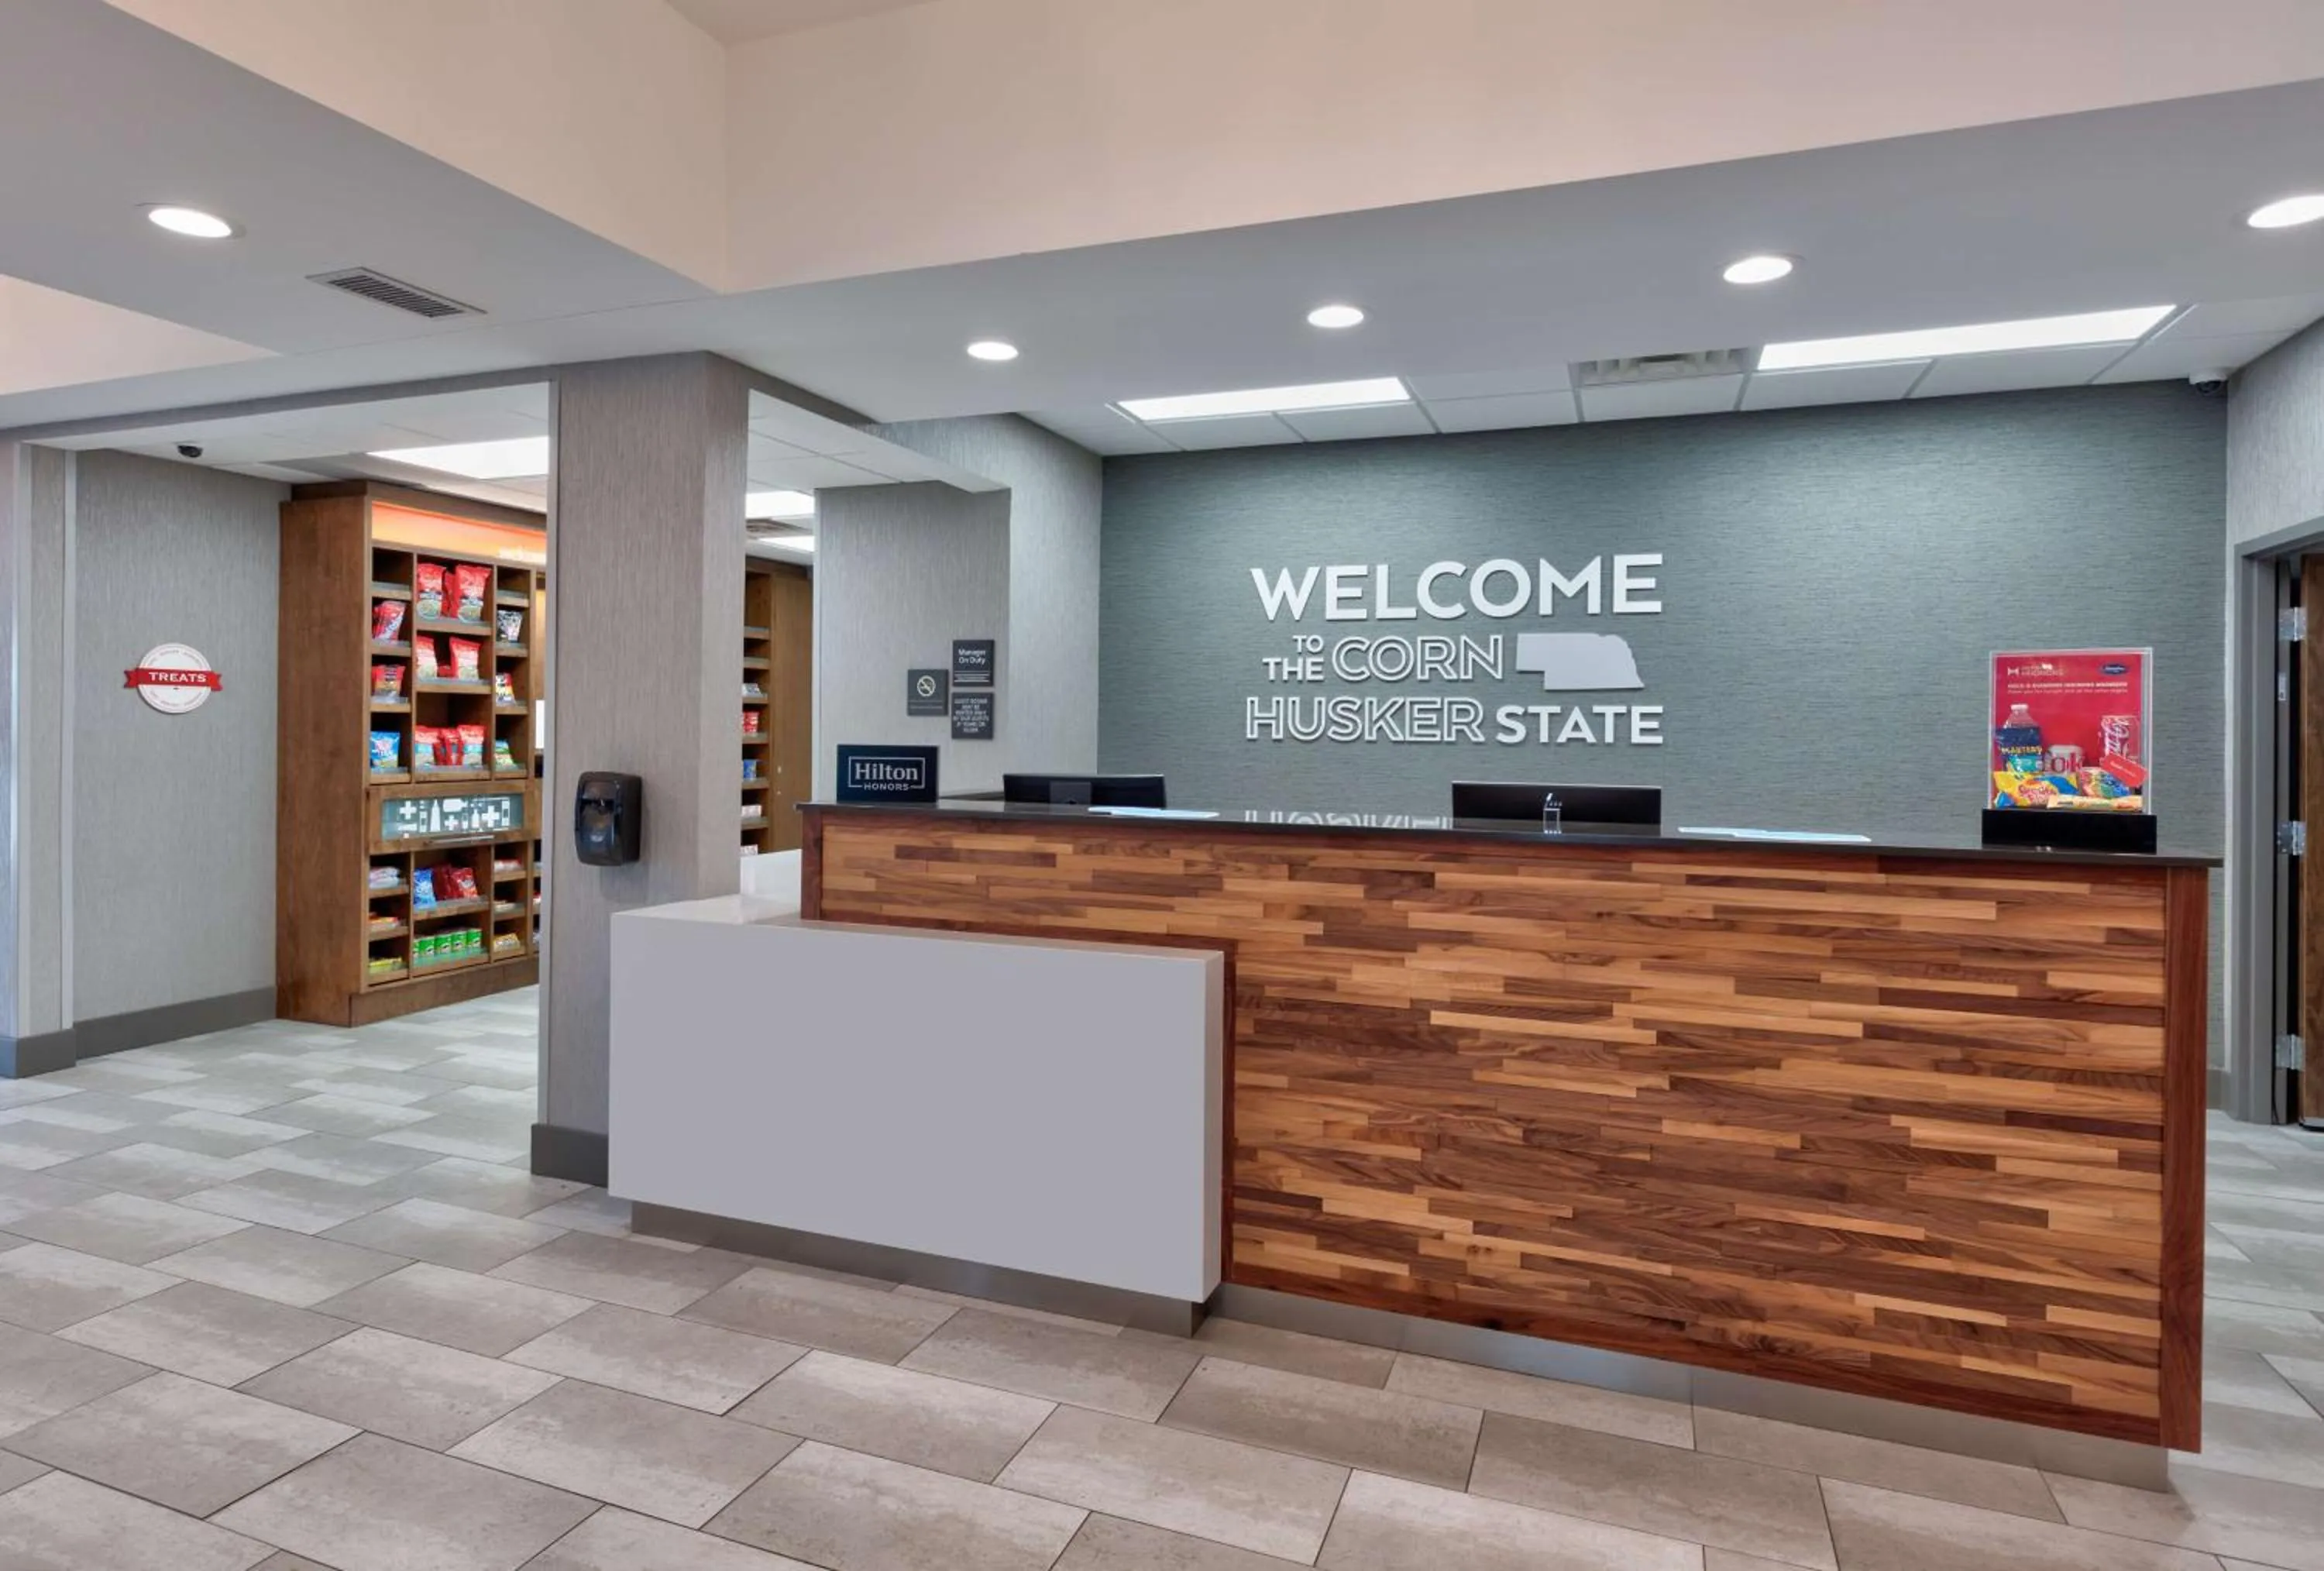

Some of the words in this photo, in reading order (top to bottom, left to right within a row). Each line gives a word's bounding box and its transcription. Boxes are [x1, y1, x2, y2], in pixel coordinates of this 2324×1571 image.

[1250, 553, 1663, 620] WELCOME
[1292, 634, 1325, 655] TO
[969, 656, 986, 665] Duty
[1262, 657, 1325, 682] THE
[1332, 634, 1504, 682] CORN
[148, 672, 207, 682] TREATS
[1246, 696, 1485, 743] HUSKER
[1496, 704, 1663, 744] STATE
[854, 762, 919, 780] Hilton
[864, 782, 909, 791] HONORS
